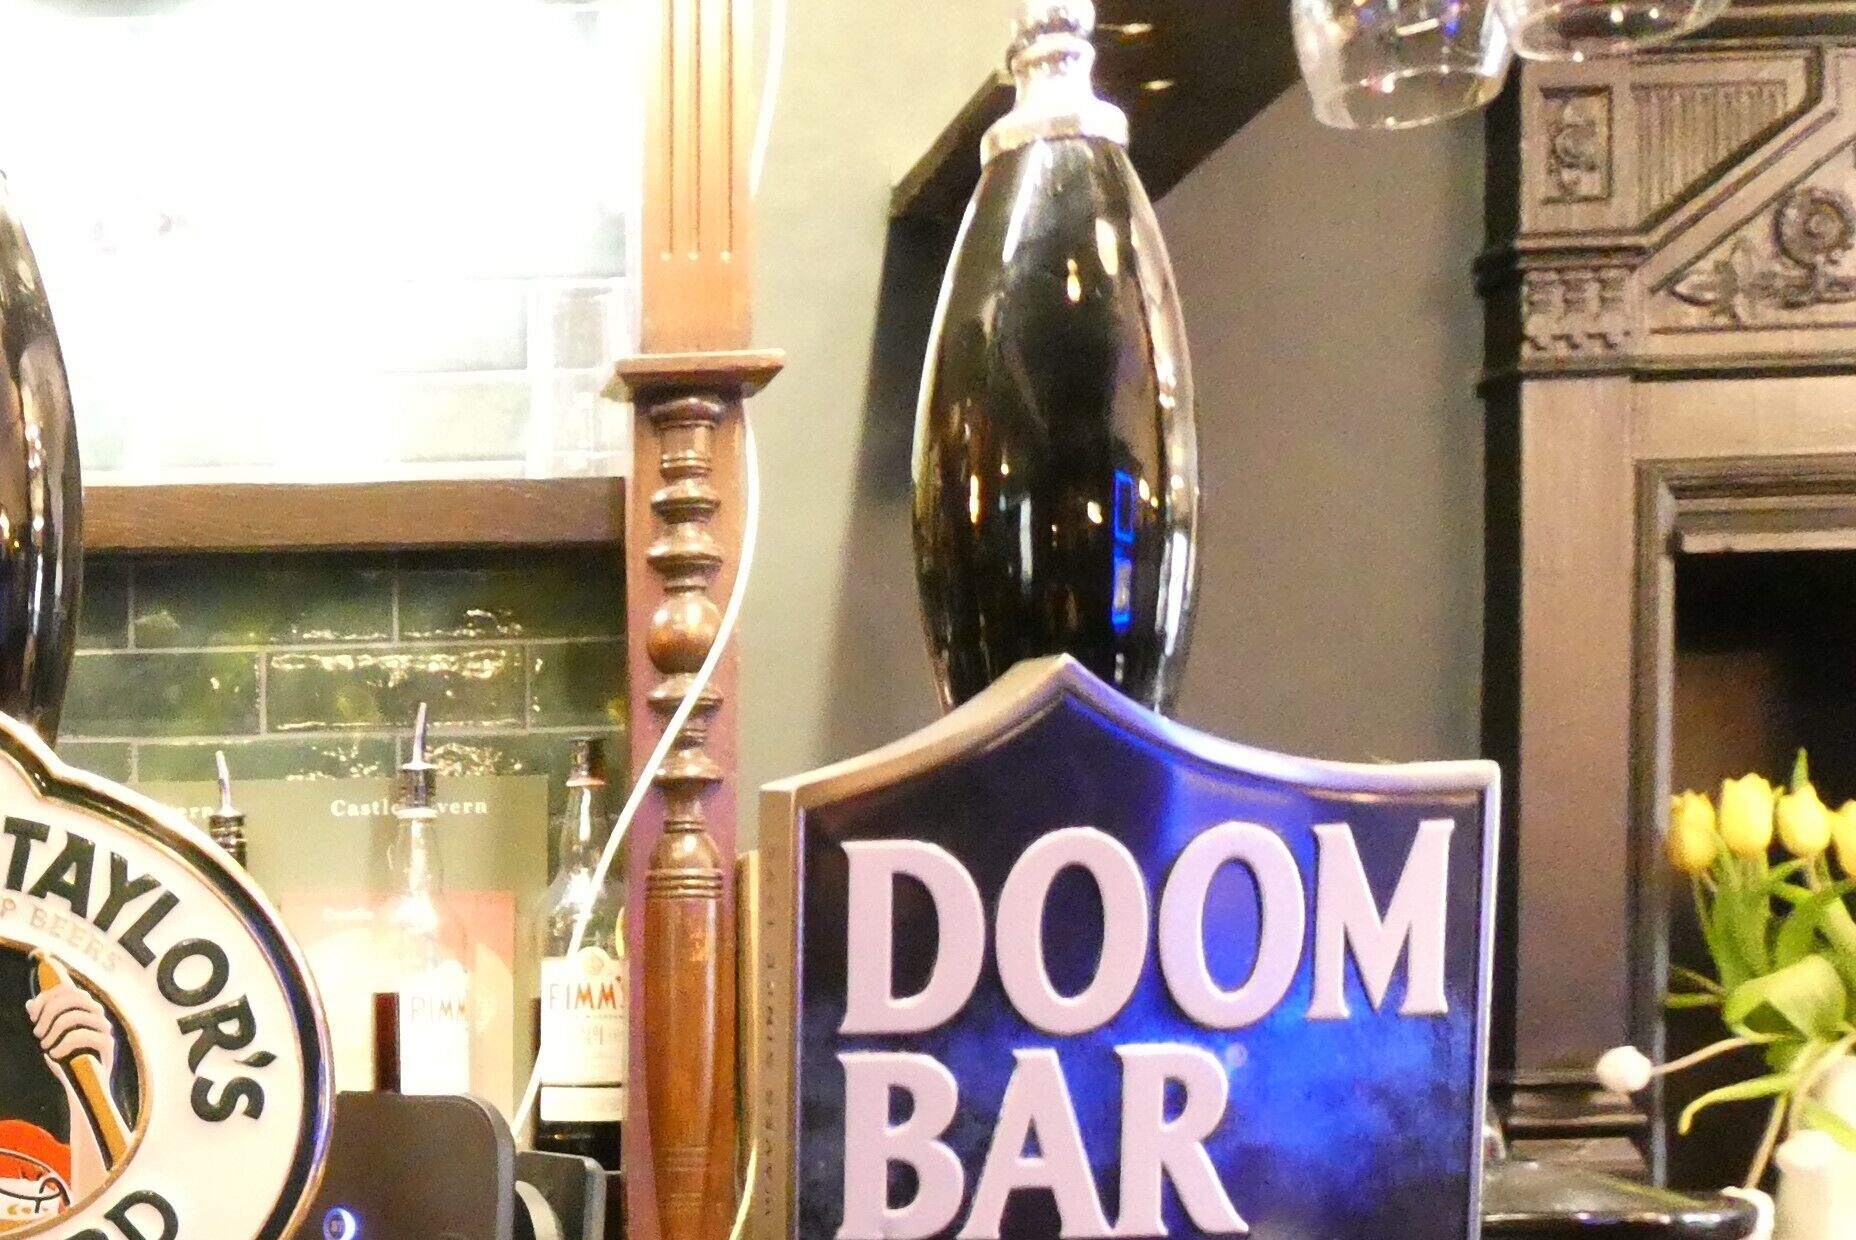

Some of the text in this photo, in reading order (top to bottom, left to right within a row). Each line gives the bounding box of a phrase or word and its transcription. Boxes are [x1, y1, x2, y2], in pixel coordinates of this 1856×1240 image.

[2, 815, 279, 1124] TAYLOR'S
[28, 905, 126, 974] BEERS
[838, 818, 1456, 1036] DOOM
